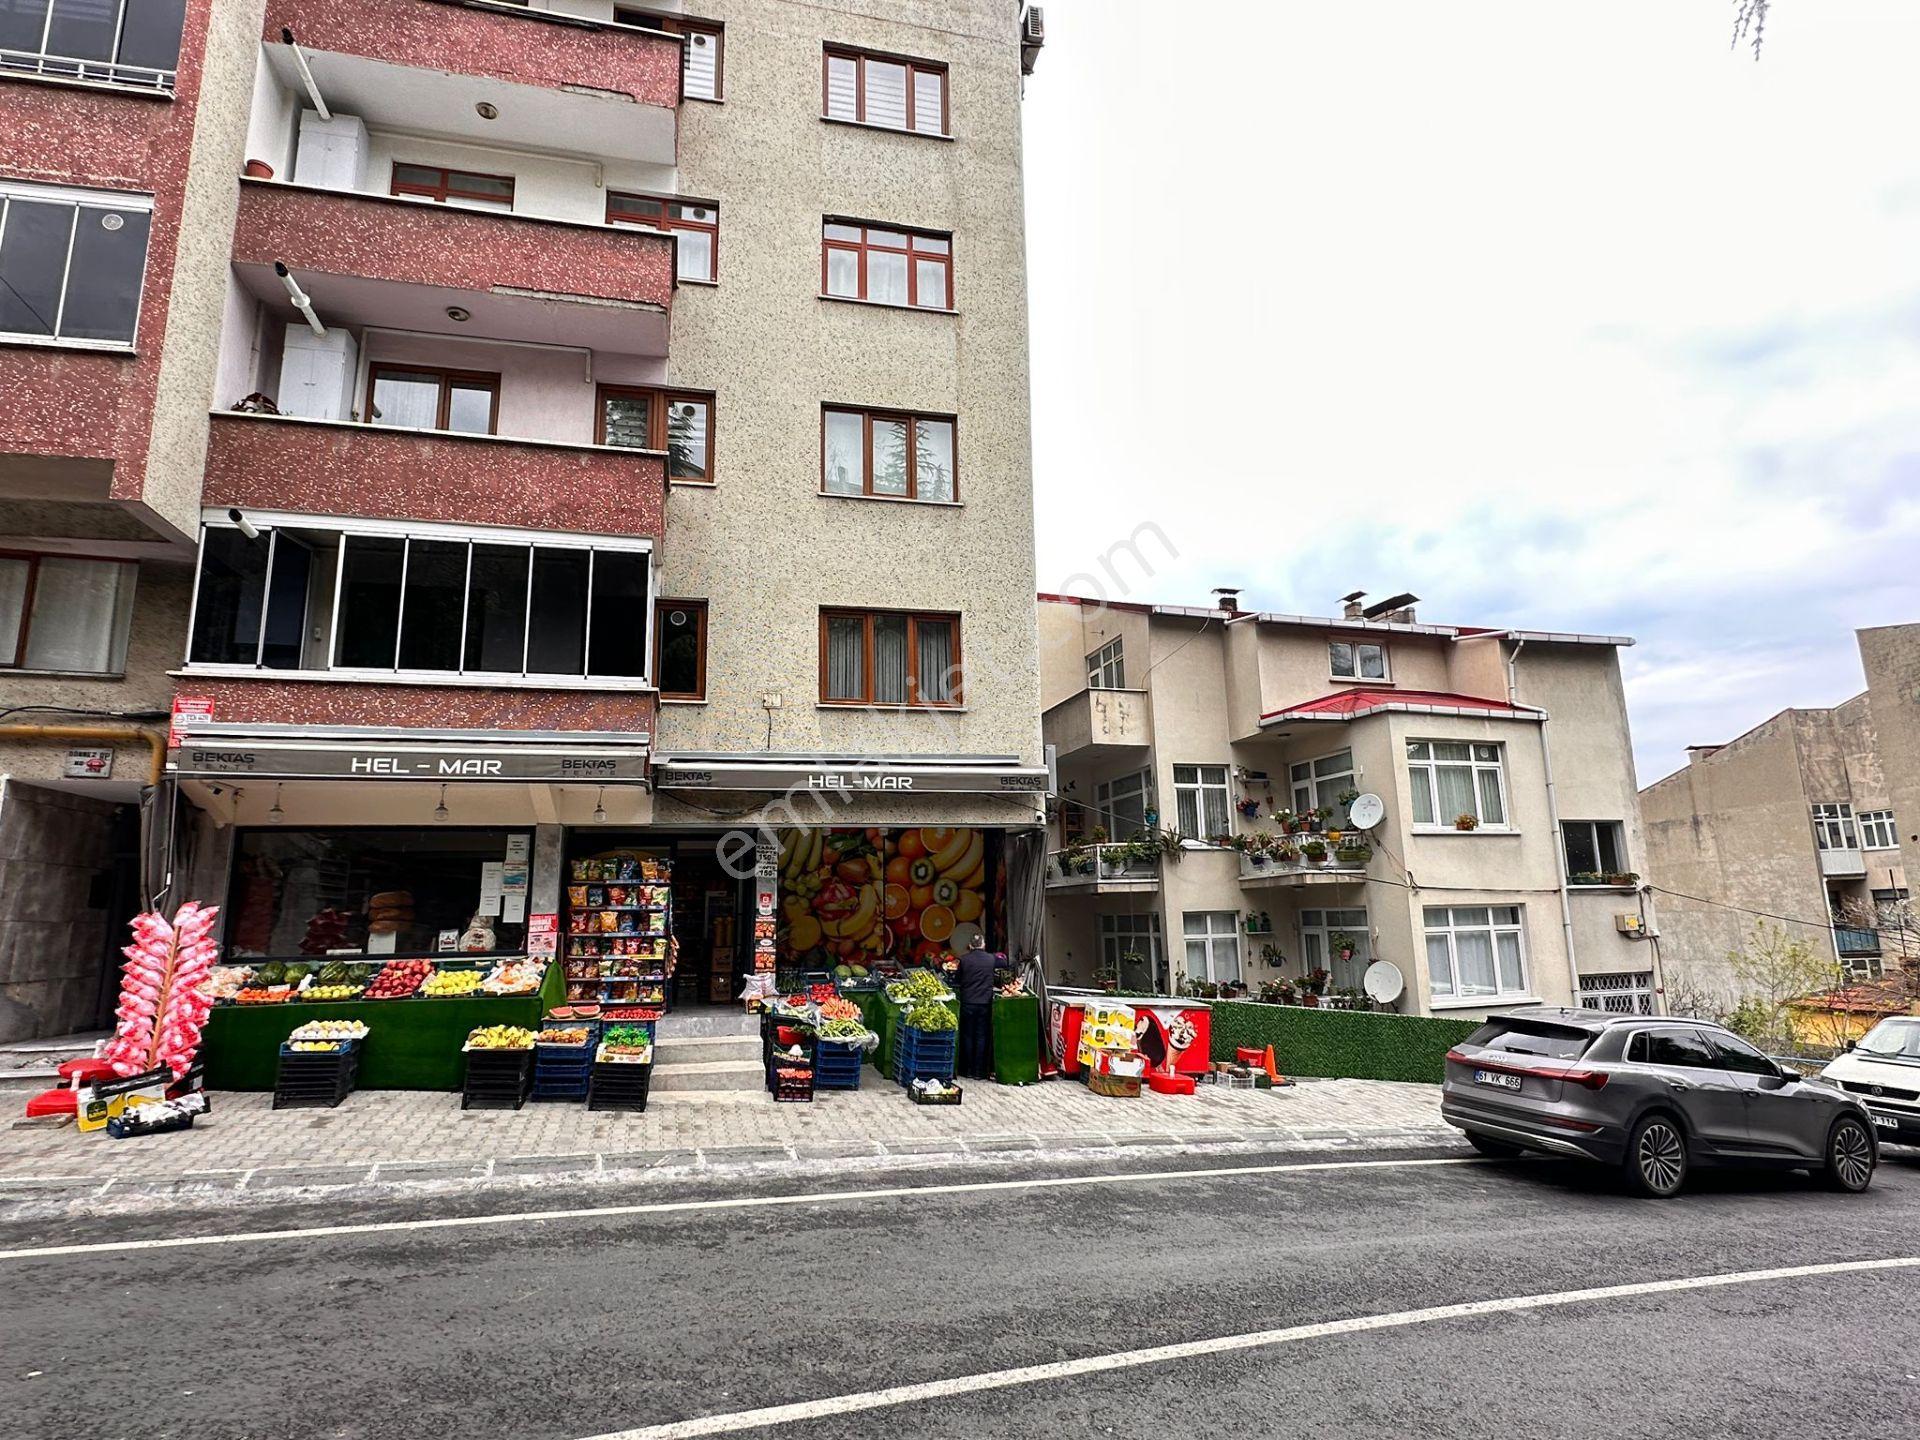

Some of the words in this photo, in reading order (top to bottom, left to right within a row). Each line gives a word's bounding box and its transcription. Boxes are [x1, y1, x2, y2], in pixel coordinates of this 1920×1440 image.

[351, 757, 410, 773] HEL
[438, 758, 502, 775] MAR
[808, 775, 913, 789] HEL-MAR
[1479, 1072, 1487, 1081] 61
[1491, 1074, 1501, 1084] VK
[1505, 1076, 1520, 1087] 666
